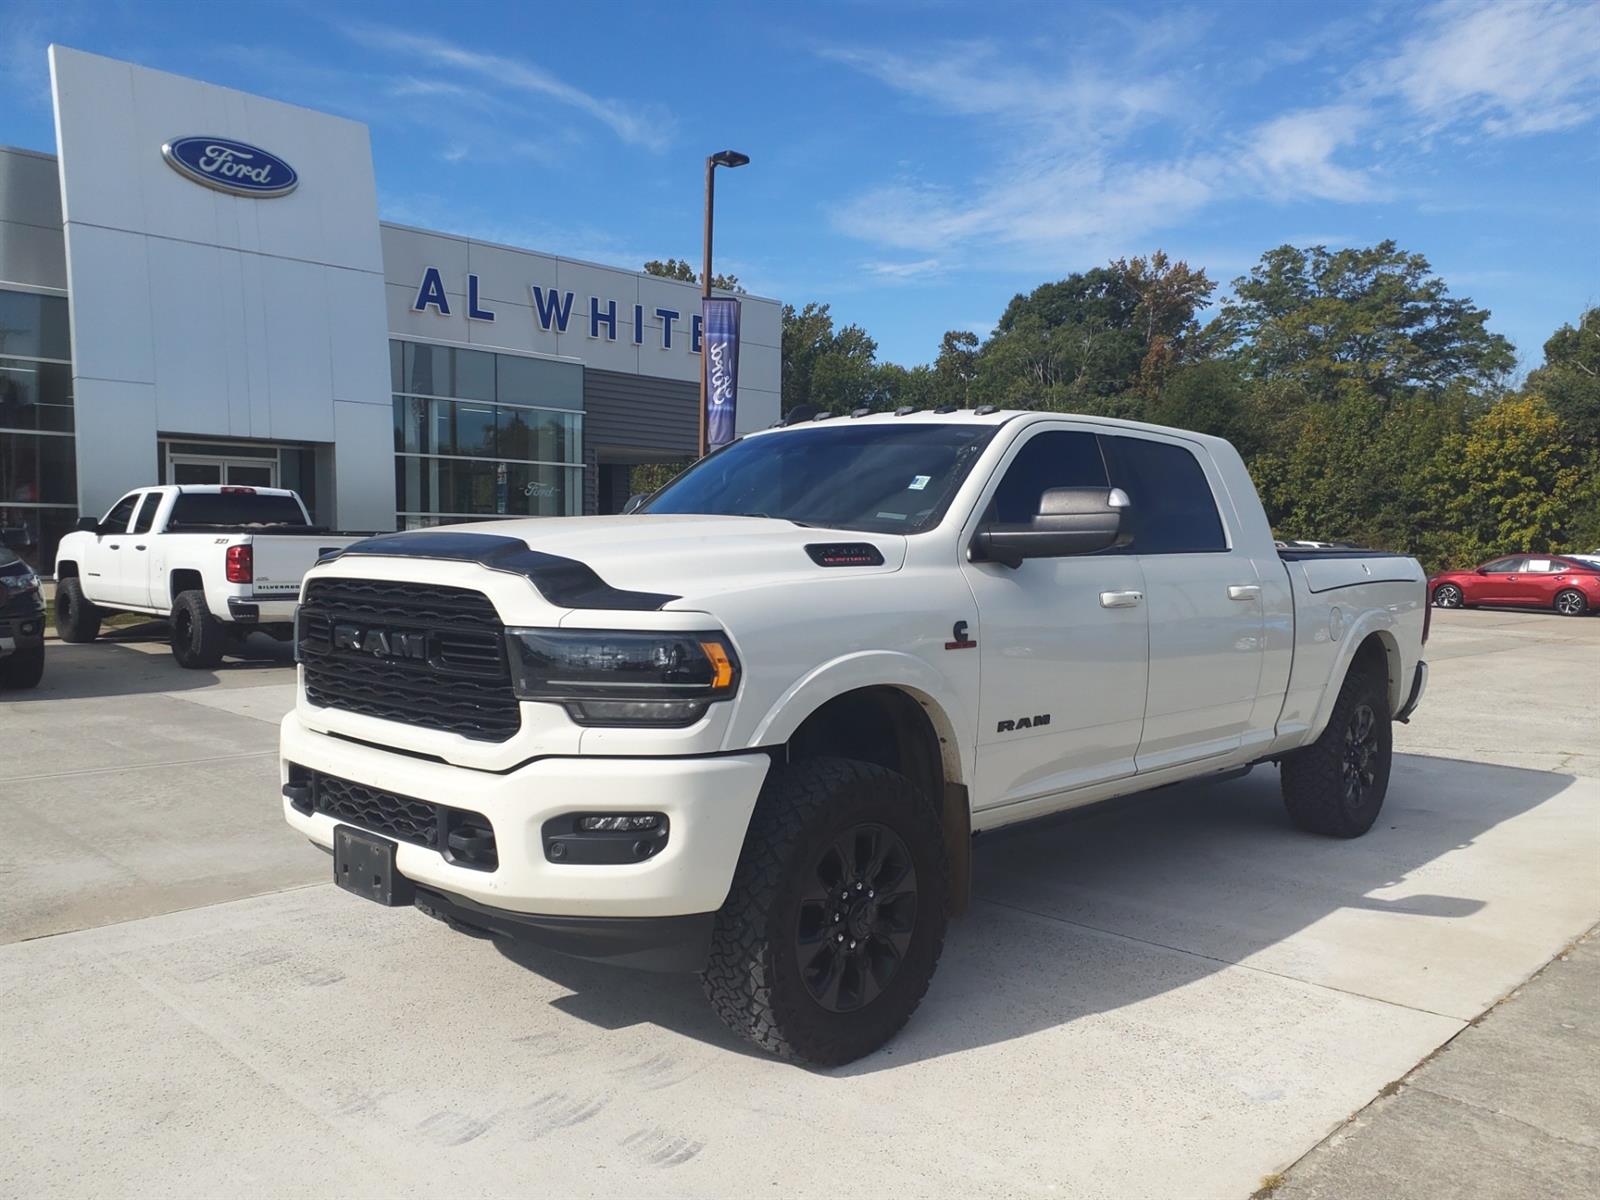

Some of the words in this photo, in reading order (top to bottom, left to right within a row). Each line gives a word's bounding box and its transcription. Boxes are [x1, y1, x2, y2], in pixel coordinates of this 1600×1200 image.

[198, 144, 272, 184] Ford
[412, 266, 497, 322] AL
[524, 481, 554, 497] Ford
[333, 624, 425, 659] RAM
[996, 713, 1051, 733] RAM
